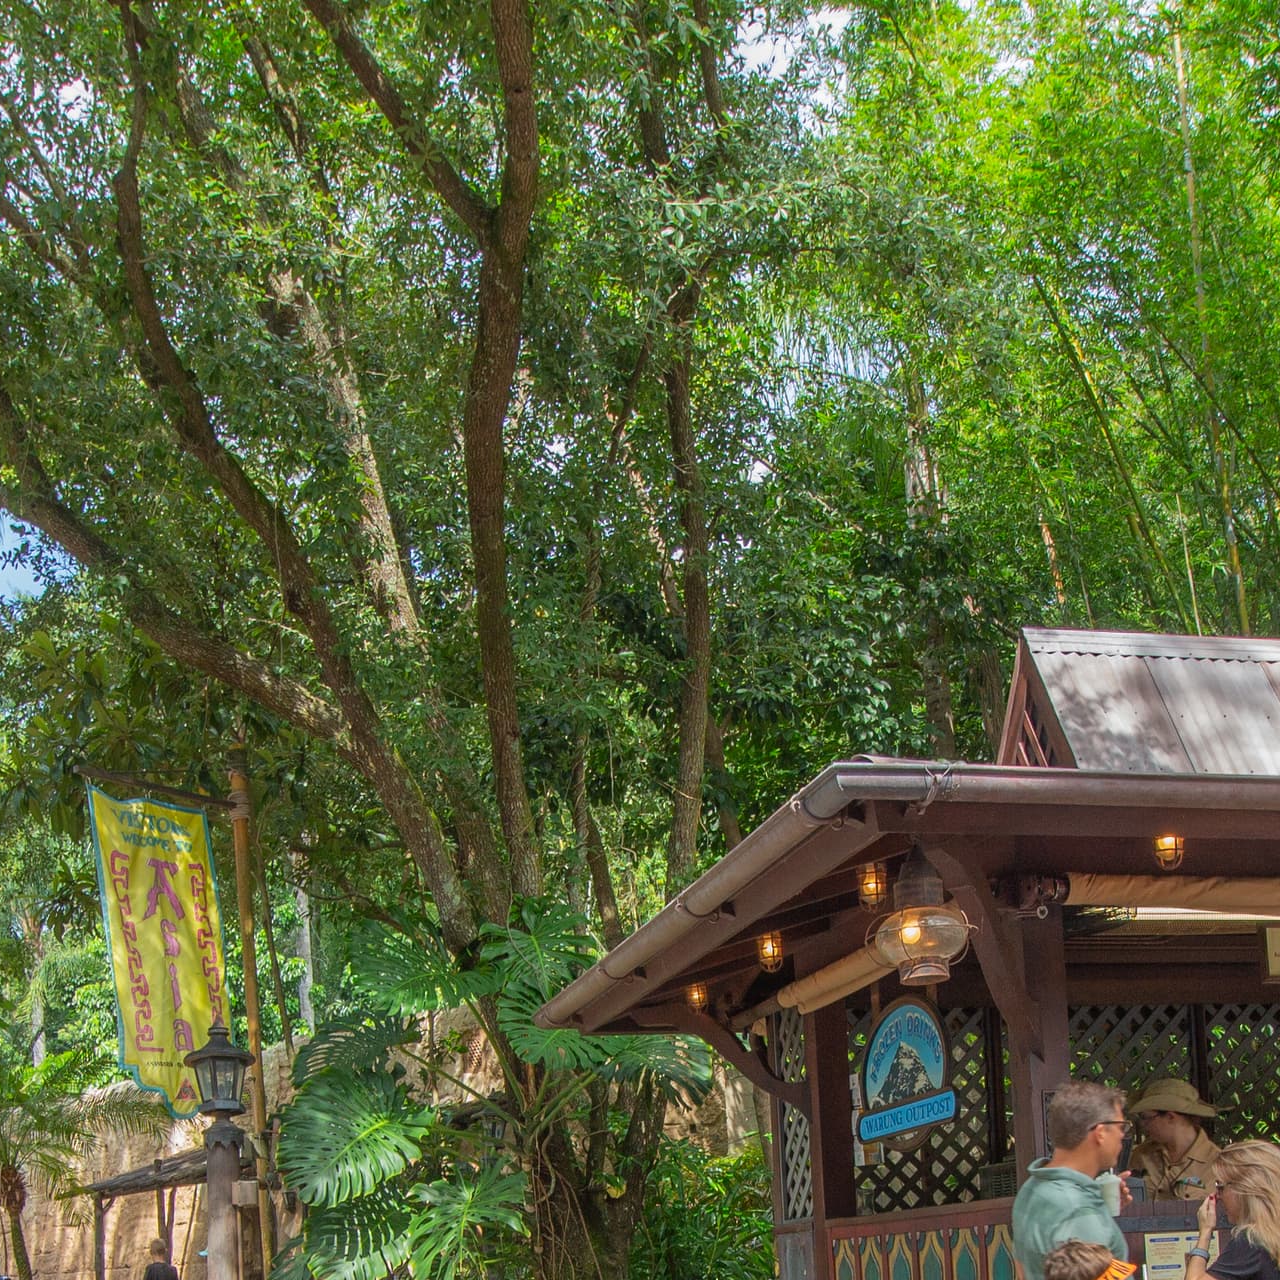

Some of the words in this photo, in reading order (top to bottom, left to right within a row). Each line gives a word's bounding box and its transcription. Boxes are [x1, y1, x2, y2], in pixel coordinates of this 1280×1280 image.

[122, 831, 171, 853] WELCOME
[143, 857, 195, 1051] Asia
[871, 1016, 903, 1084] FROZEN
[905, 1012, 943, 1064] DRINKS
[865, 1110, 903, 1134] WARUNG
[906, 1097, 951, 1122] OUTPOST
